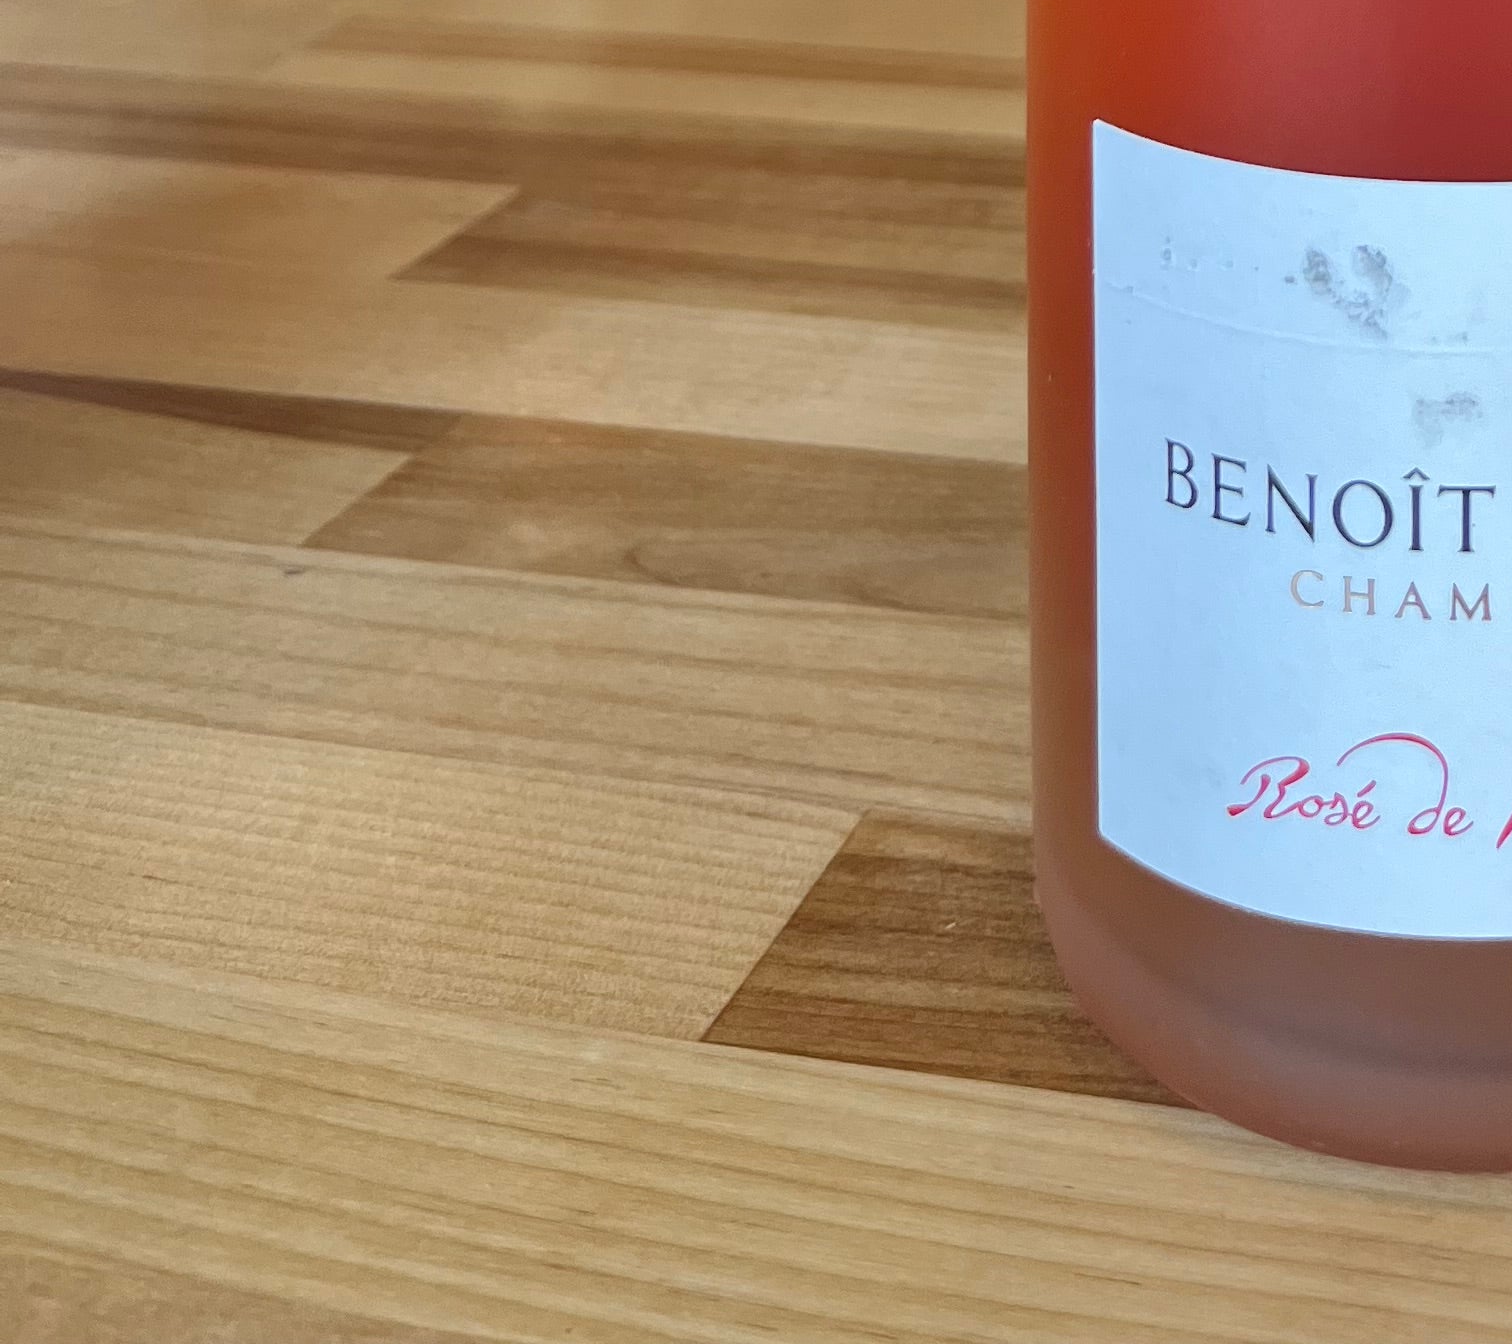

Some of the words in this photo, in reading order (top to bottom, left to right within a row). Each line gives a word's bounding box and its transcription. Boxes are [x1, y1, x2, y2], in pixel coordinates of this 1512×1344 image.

[1163, 435, 1498, 553] BENOÎT
[1225, 754, 1382, 830] Rosé
[1335, 731, 1475, 837] de
